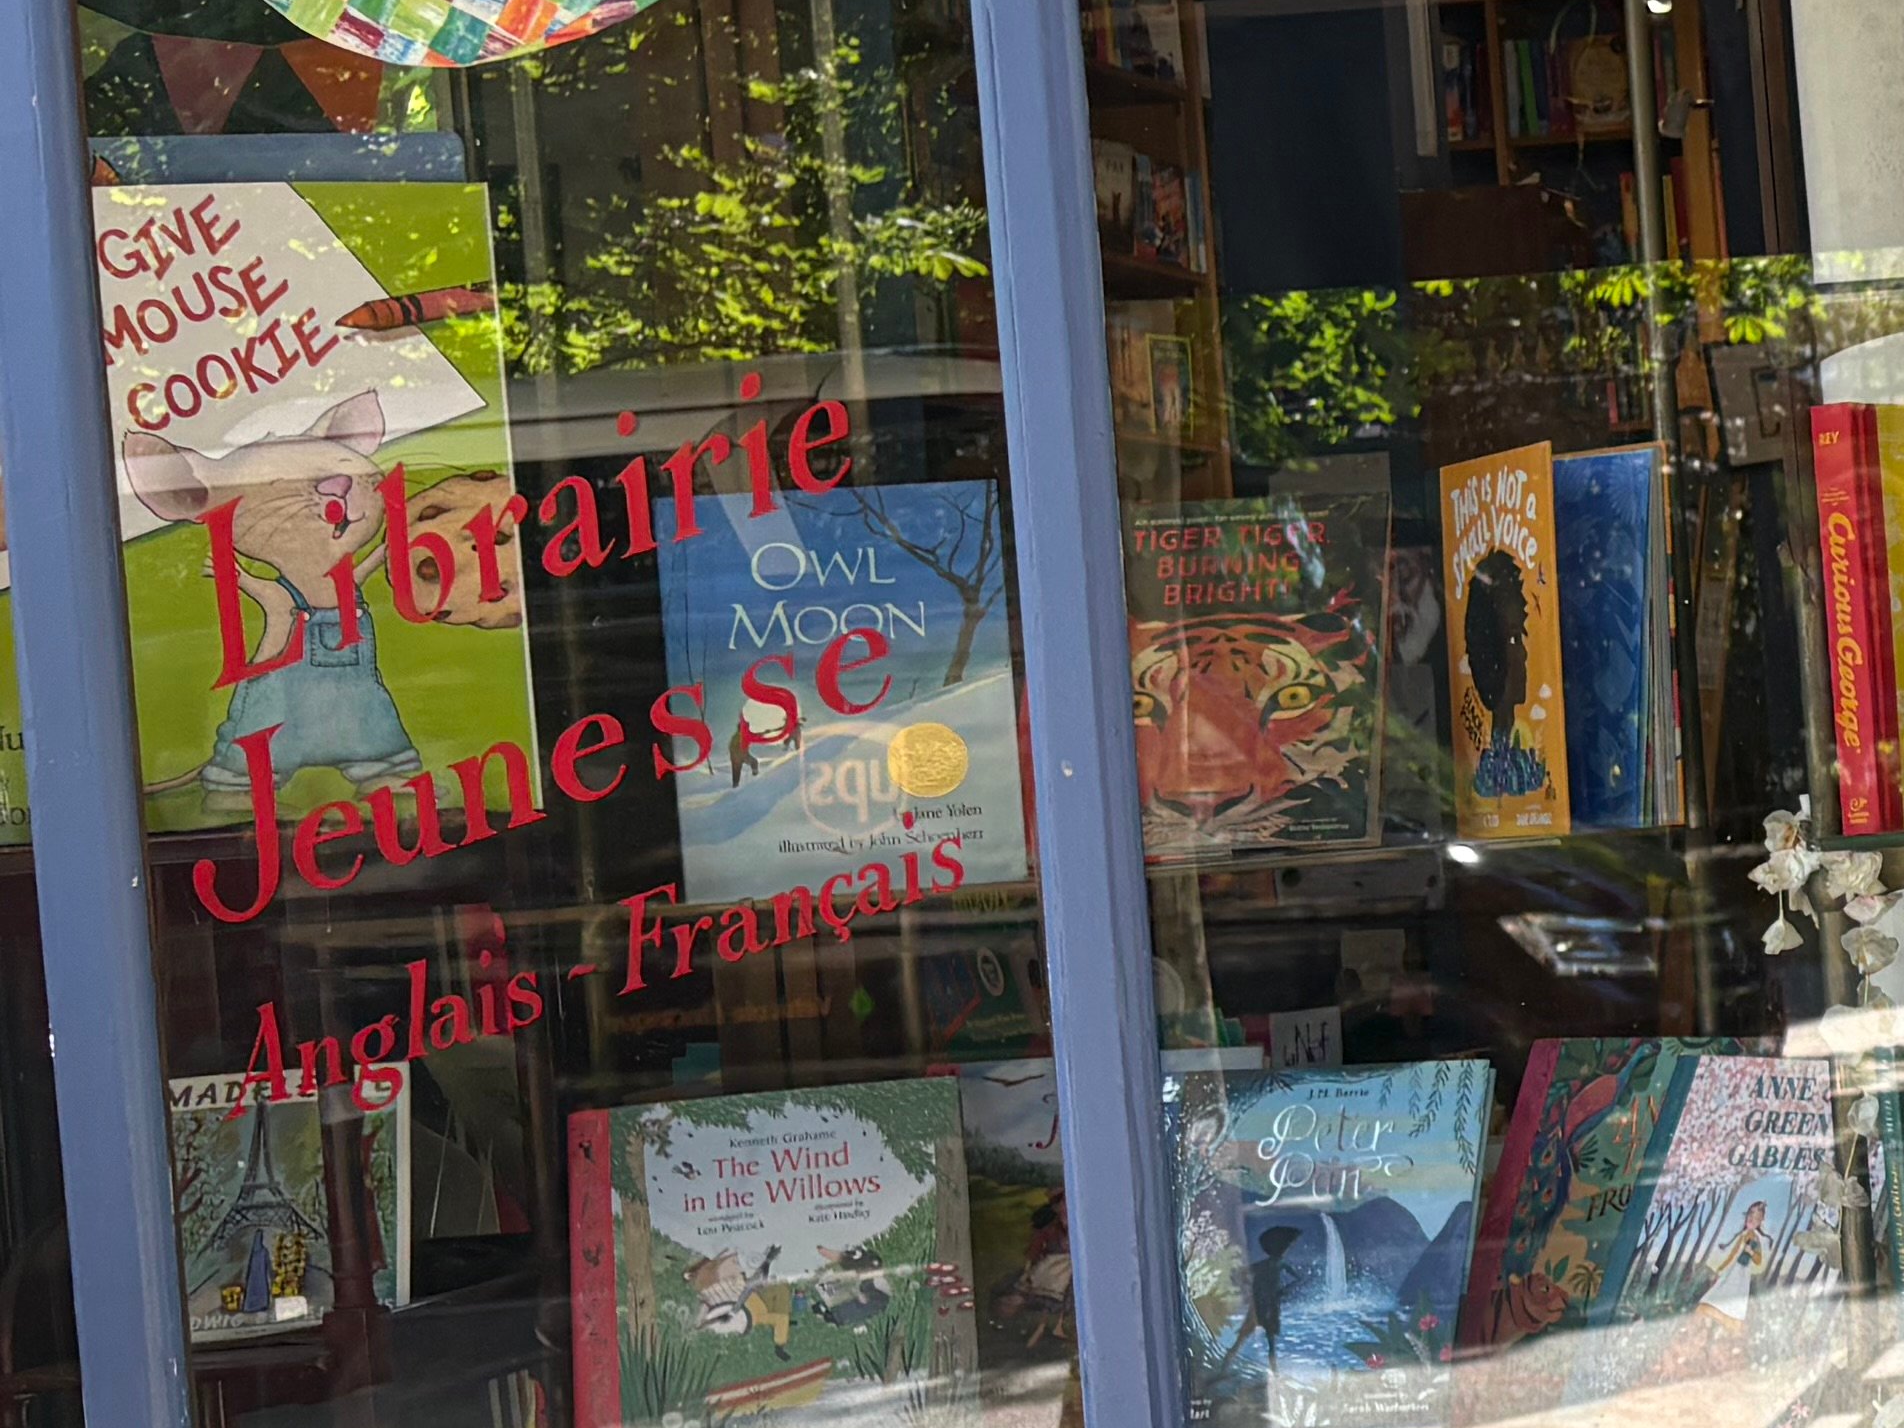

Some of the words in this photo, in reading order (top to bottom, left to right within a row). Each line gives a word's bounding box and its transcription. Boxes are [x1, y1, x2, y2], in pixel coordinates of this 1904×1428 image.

[98, 193, 242, 281] GIVE
[103, 255, 290, 367] MOUSE
[127, 307, 341, 431] COOKIE
[1818, 431, 1840, 447] REY
[199, 371, 852, 690] Librairie
[1134, 525, 1223, 553] TIGER
[751, 542, 896, 591] OWL
[1158, 551, 1301, 581] BURNING
[1826, 511, 1857, 642] Curious
[1162, 577, 1292, 607] BRIGHT!
[728, 600, 926, 650] MOON
[1836, 642, 1864, 757] George
[193, 625, 893, 923] Jeunesse
[224, 911, 542, 1121] Anglais
[617, 809, 964, 996] Français
[1749, 1074, 1817, 1102] ANNE
[729, 1133, 778, 1149] Kenneth
[1258, 1103, 1396, 1160] Peter
[1744, 1109, 1831, 1137] GREEN
[713, 1155, 760, 1180] The
[770, 1141, 851, 1173] Wind
[1255, 1151, 1362, 1207] Pan
[1728, 1144, 1827, 1172] GABLES
[682, 1193, 705, 1212] in
[715, 1188, 754, 1211] the
[764, 1173, 882, 1205] Willows
